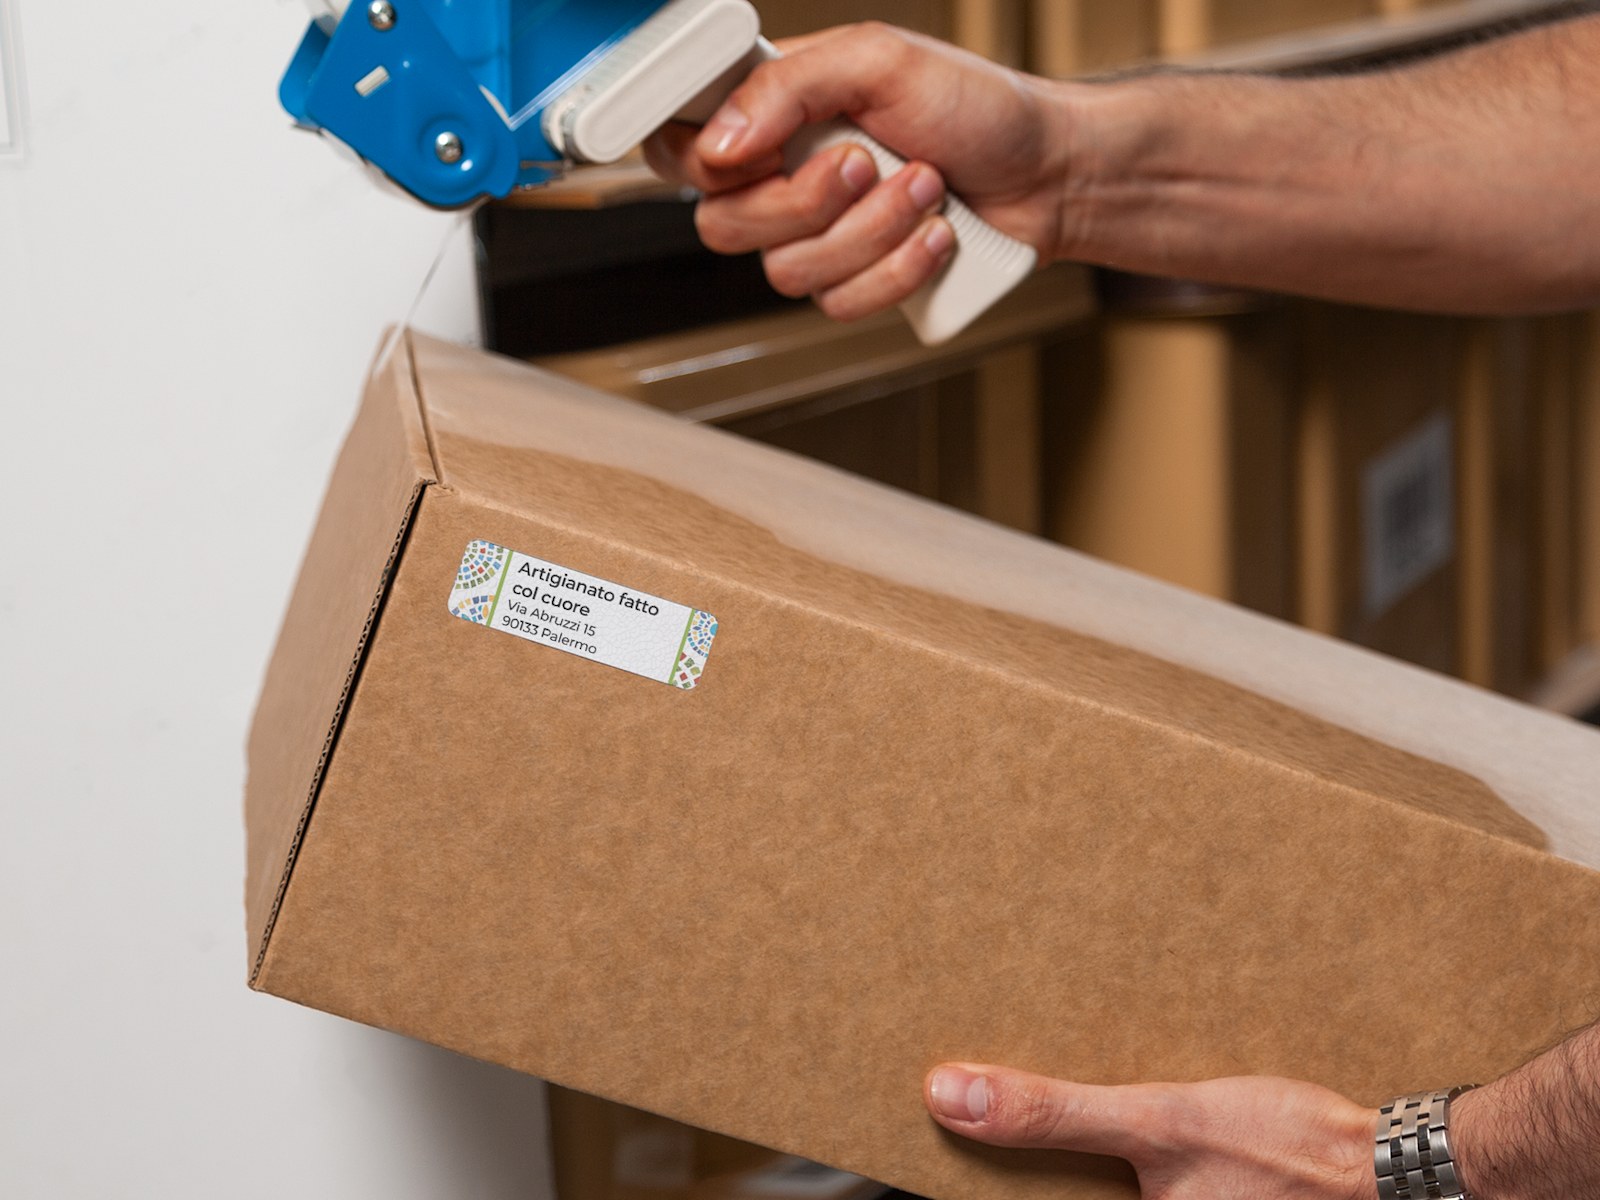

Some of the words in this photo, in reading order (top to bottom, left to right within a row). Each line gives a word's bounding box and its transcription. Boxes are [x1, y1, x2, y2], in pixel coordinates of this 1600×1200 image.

[512, 584, 539, 600] col
[541, 593, 591, 616] cuore
[517, 562, 615, 602] Artigianato
[618, 592, 660, 616] fatto
[501, 615, 539, 636] 90133
[541, 628, 597, 654] Palermo
[508, 599, 527, 615] Via
[529, 608, 582, 632] Abruzzi
[584, 623, 596, 637] 15
